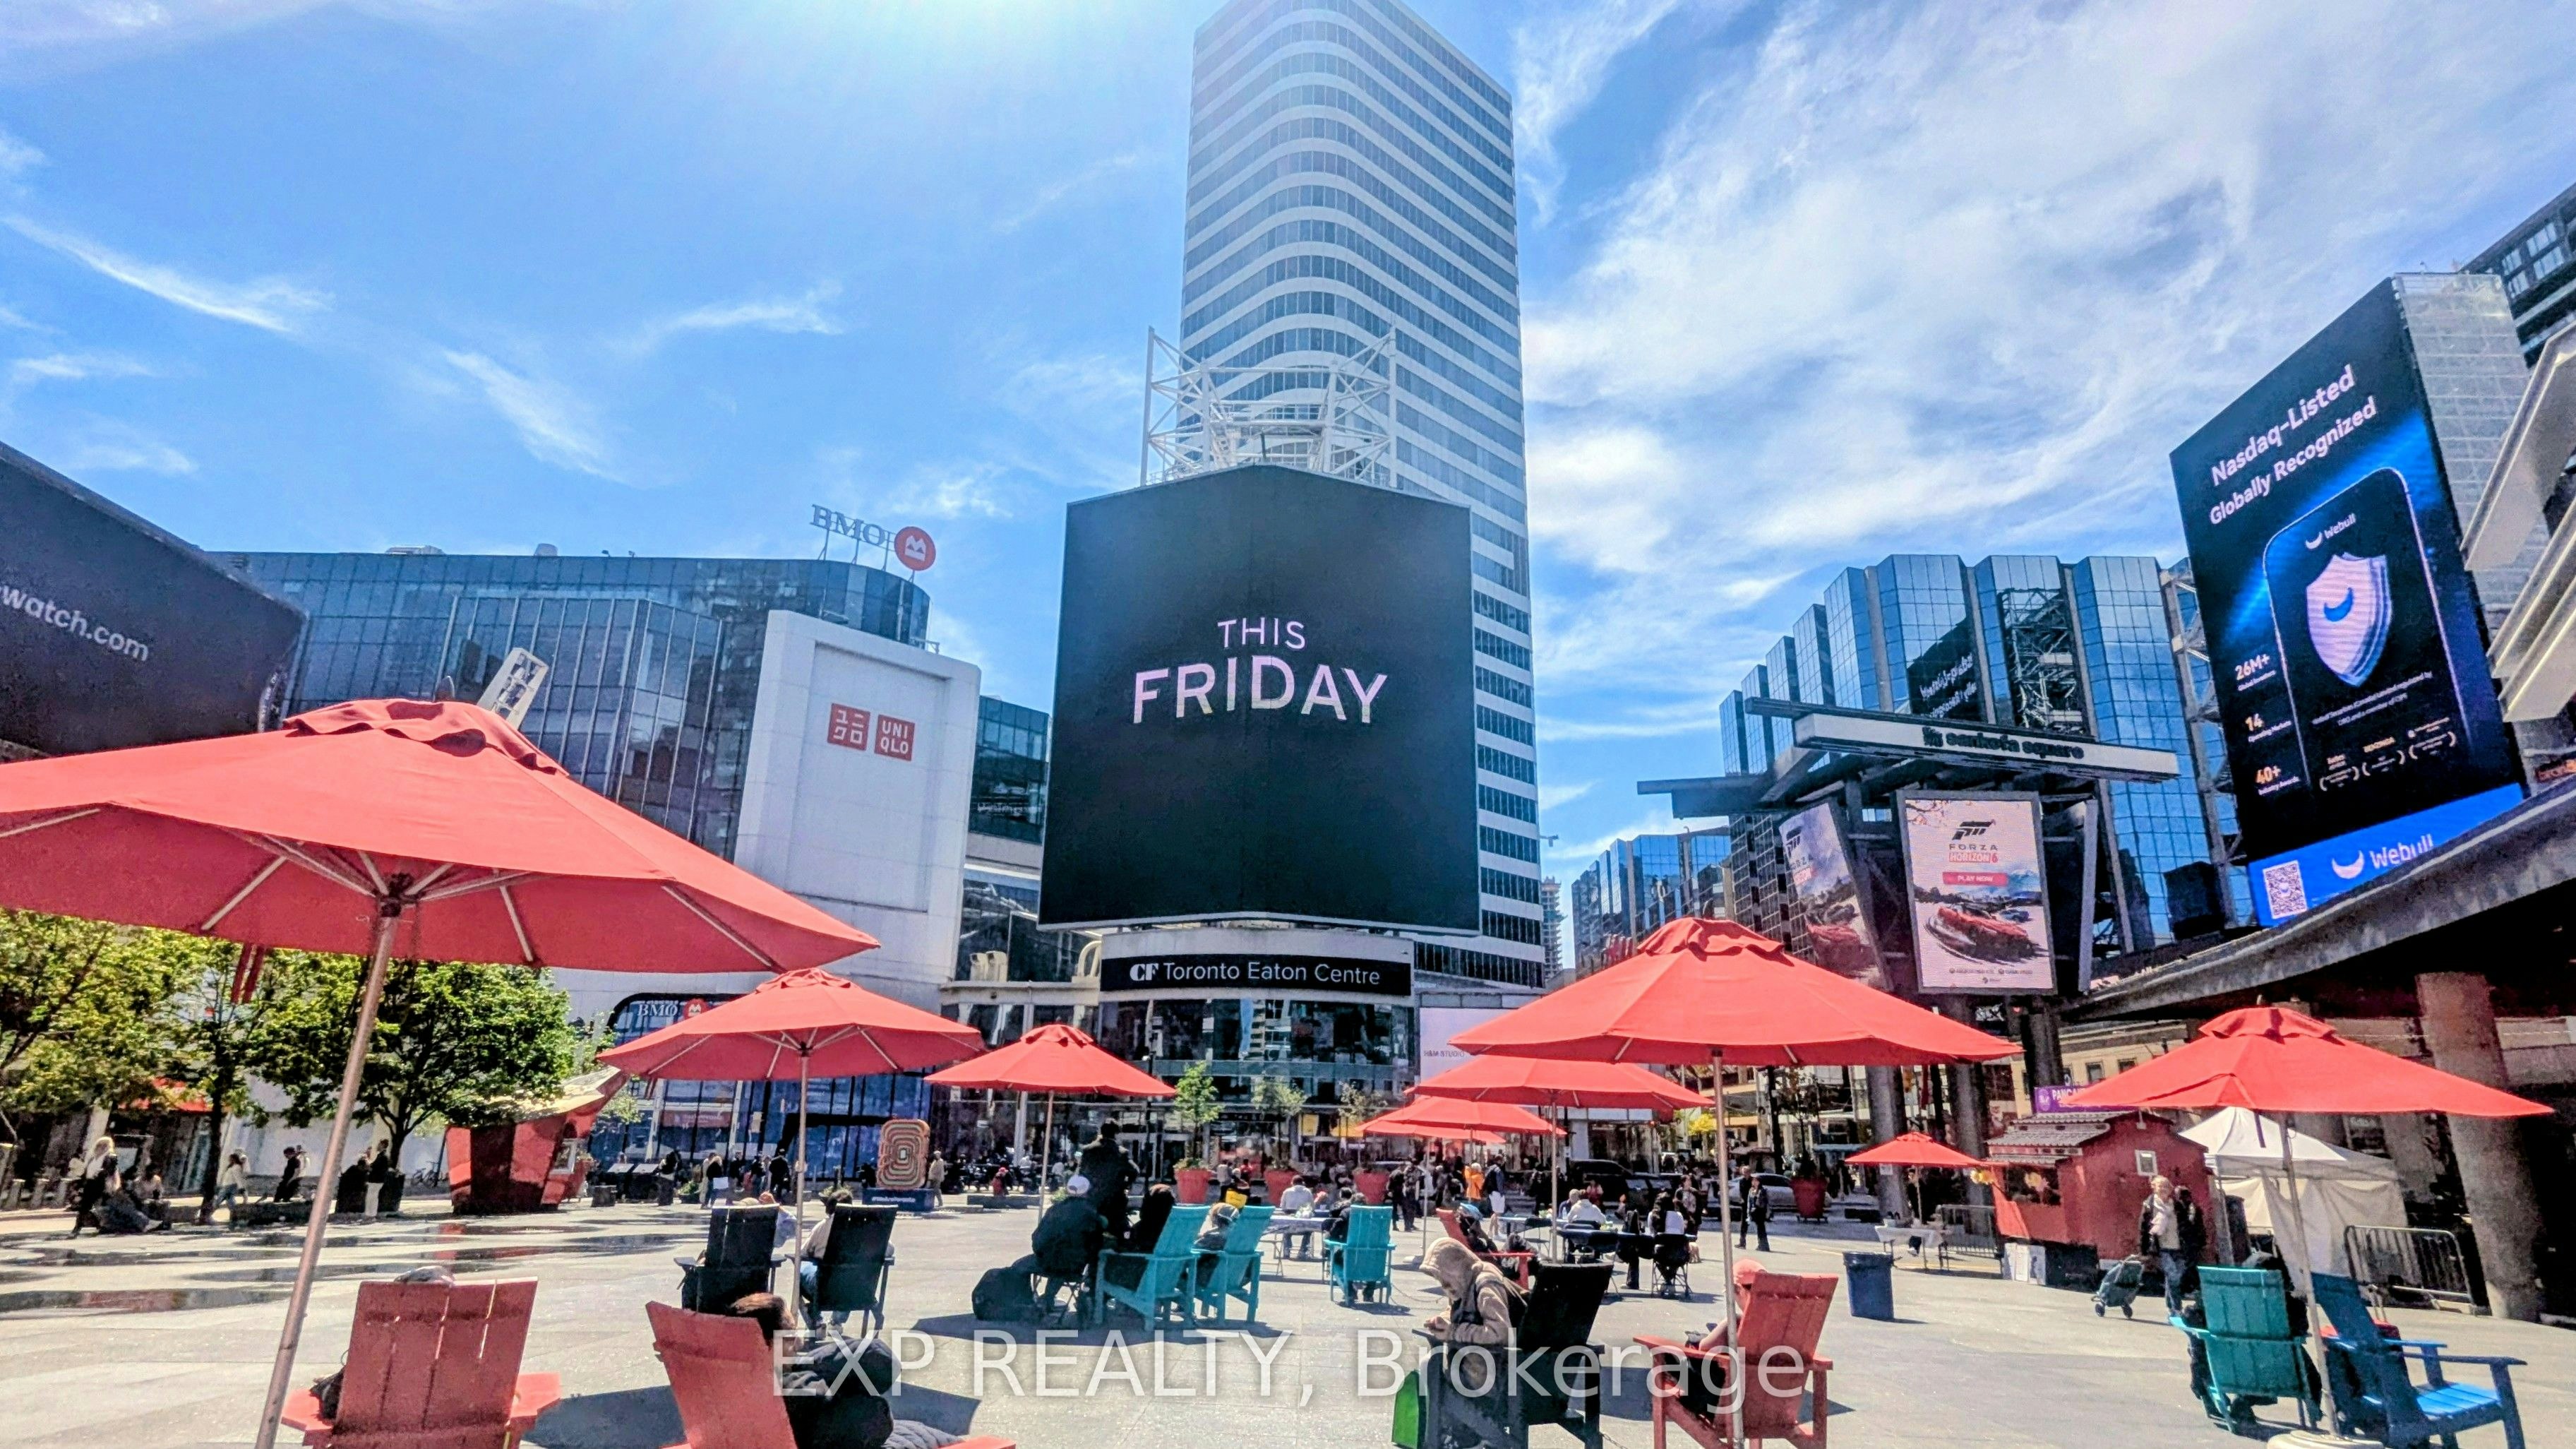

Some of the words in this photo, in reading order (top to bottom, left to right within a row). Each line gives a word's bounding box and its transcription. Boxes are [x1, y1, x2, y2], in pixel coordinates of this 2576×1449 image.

[2211, 364, 2355, 487] Nasdaq-Listed
[2210, 474, 2271, 525] Globally
[2274, 395, 2377, 481] Recognized
[810, 504, 885, 547] BMO
[2324, 513, 2356, 539] Webull
[0, 585, 148, 661] watch.com
[1217, 616, 1307, 650] THIS
[2234, 654, 2270, 681] 26M+
[1133, 655, 1388, 724] FRIDAY
[882, 720, 909, 739] UNI
[2246, 713, 2263, 732] 14
[880, 737, 909, 754] QLO
[2256, 765, 2281, 784] 40+
[1949, 852, 1990, 862] HORIZON
[2369, 833, 2433, 869] Webull
[1130, 963, 1158, 981] CF
[1163, 962, 1240, 980] Toronto
[1248, 961, 1306, 981] Eaton
[1314, 964, 1380, 984] Centre
[637, 1003, 678, 1016] BMO
